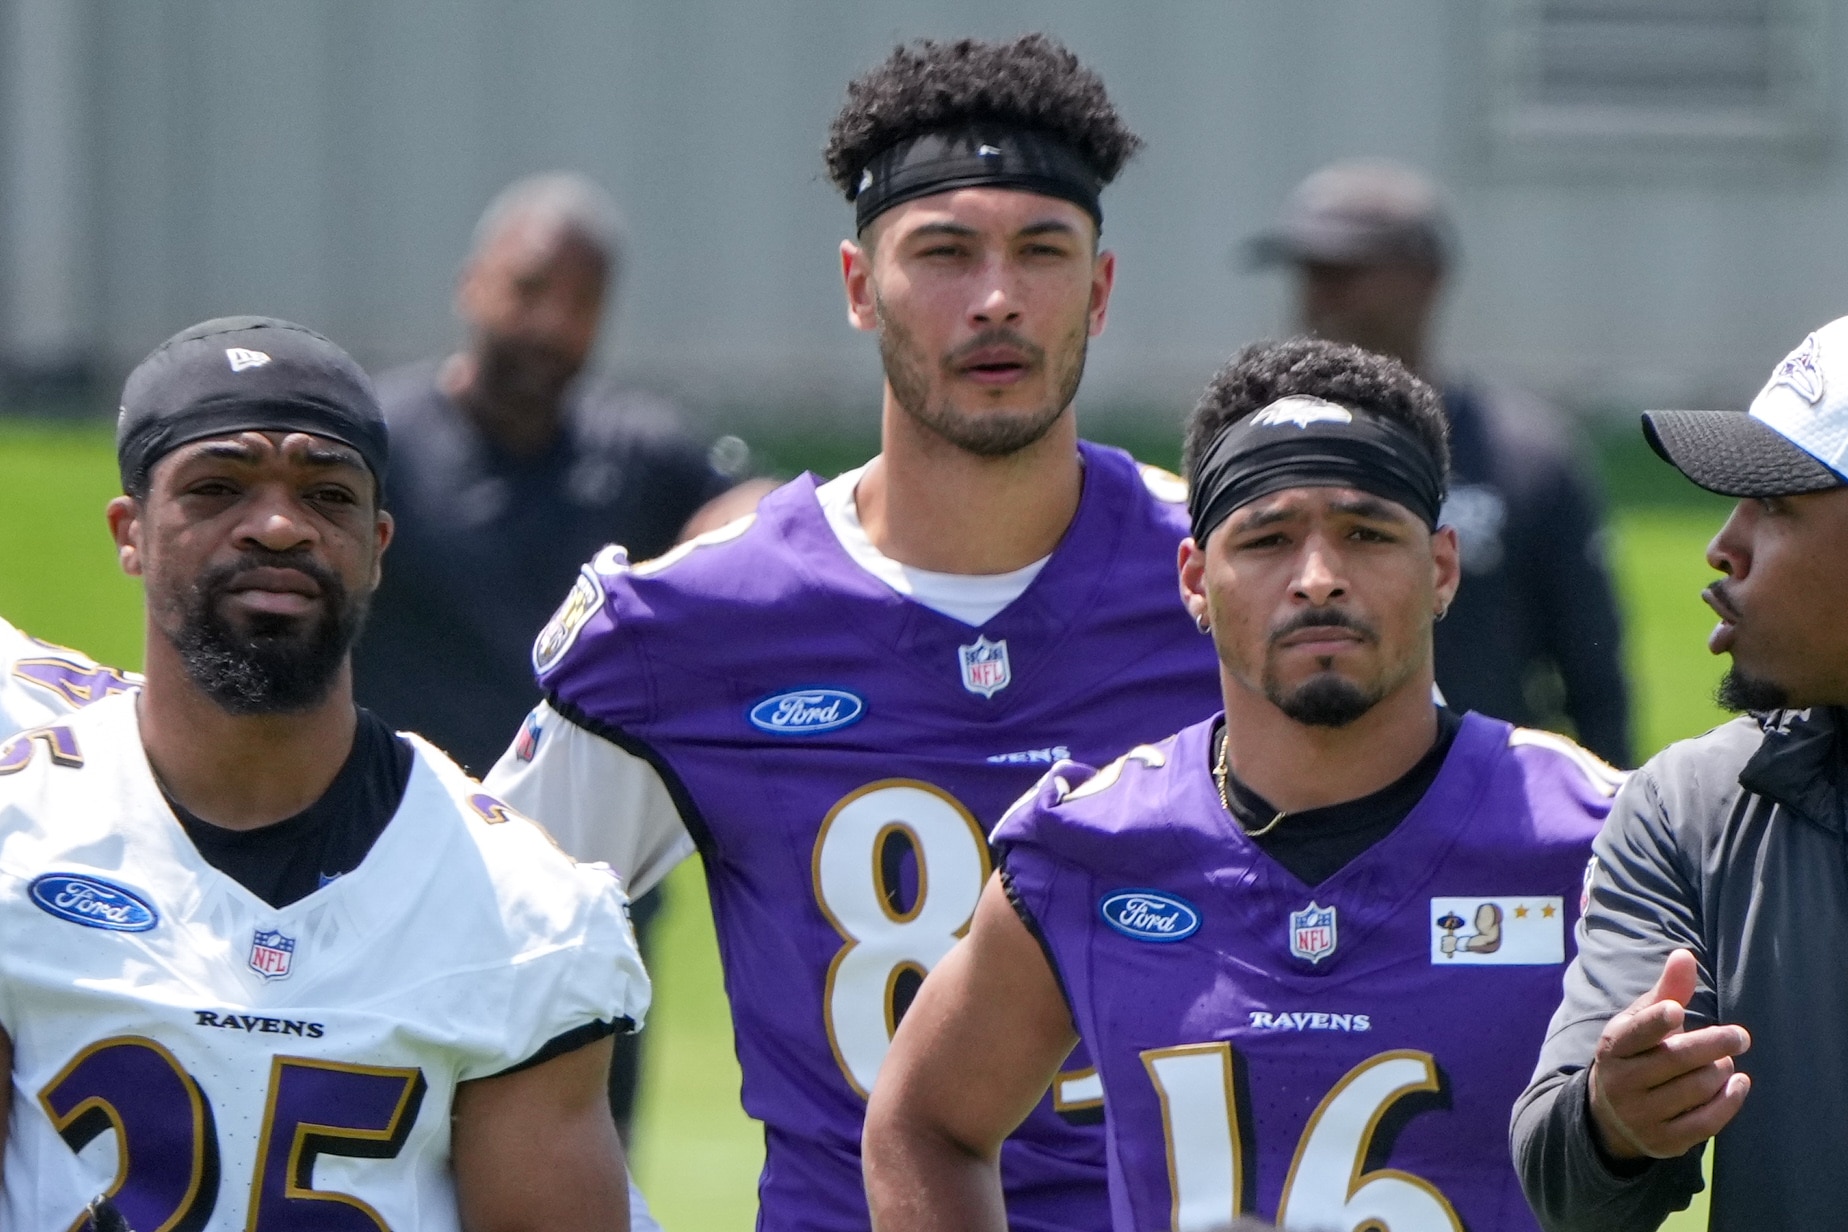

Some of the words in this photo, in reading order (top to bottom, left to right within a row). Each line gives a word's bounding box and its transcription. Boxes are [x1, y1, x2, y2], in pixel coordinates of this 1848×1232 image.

[971, 661, 1004, 686] NFL
[771, 695, 841, 726] Ford
[55, 882, 133, 923] Ford
[1119, 898, 1180, 933] Ford
[1297, 928, 1329, 952] NFL
[252, 946, 287, 973] NFL
[194, 1010, 325, 1039] RAVENS
[1249, 1011, 1371, 1032] RAVENS
